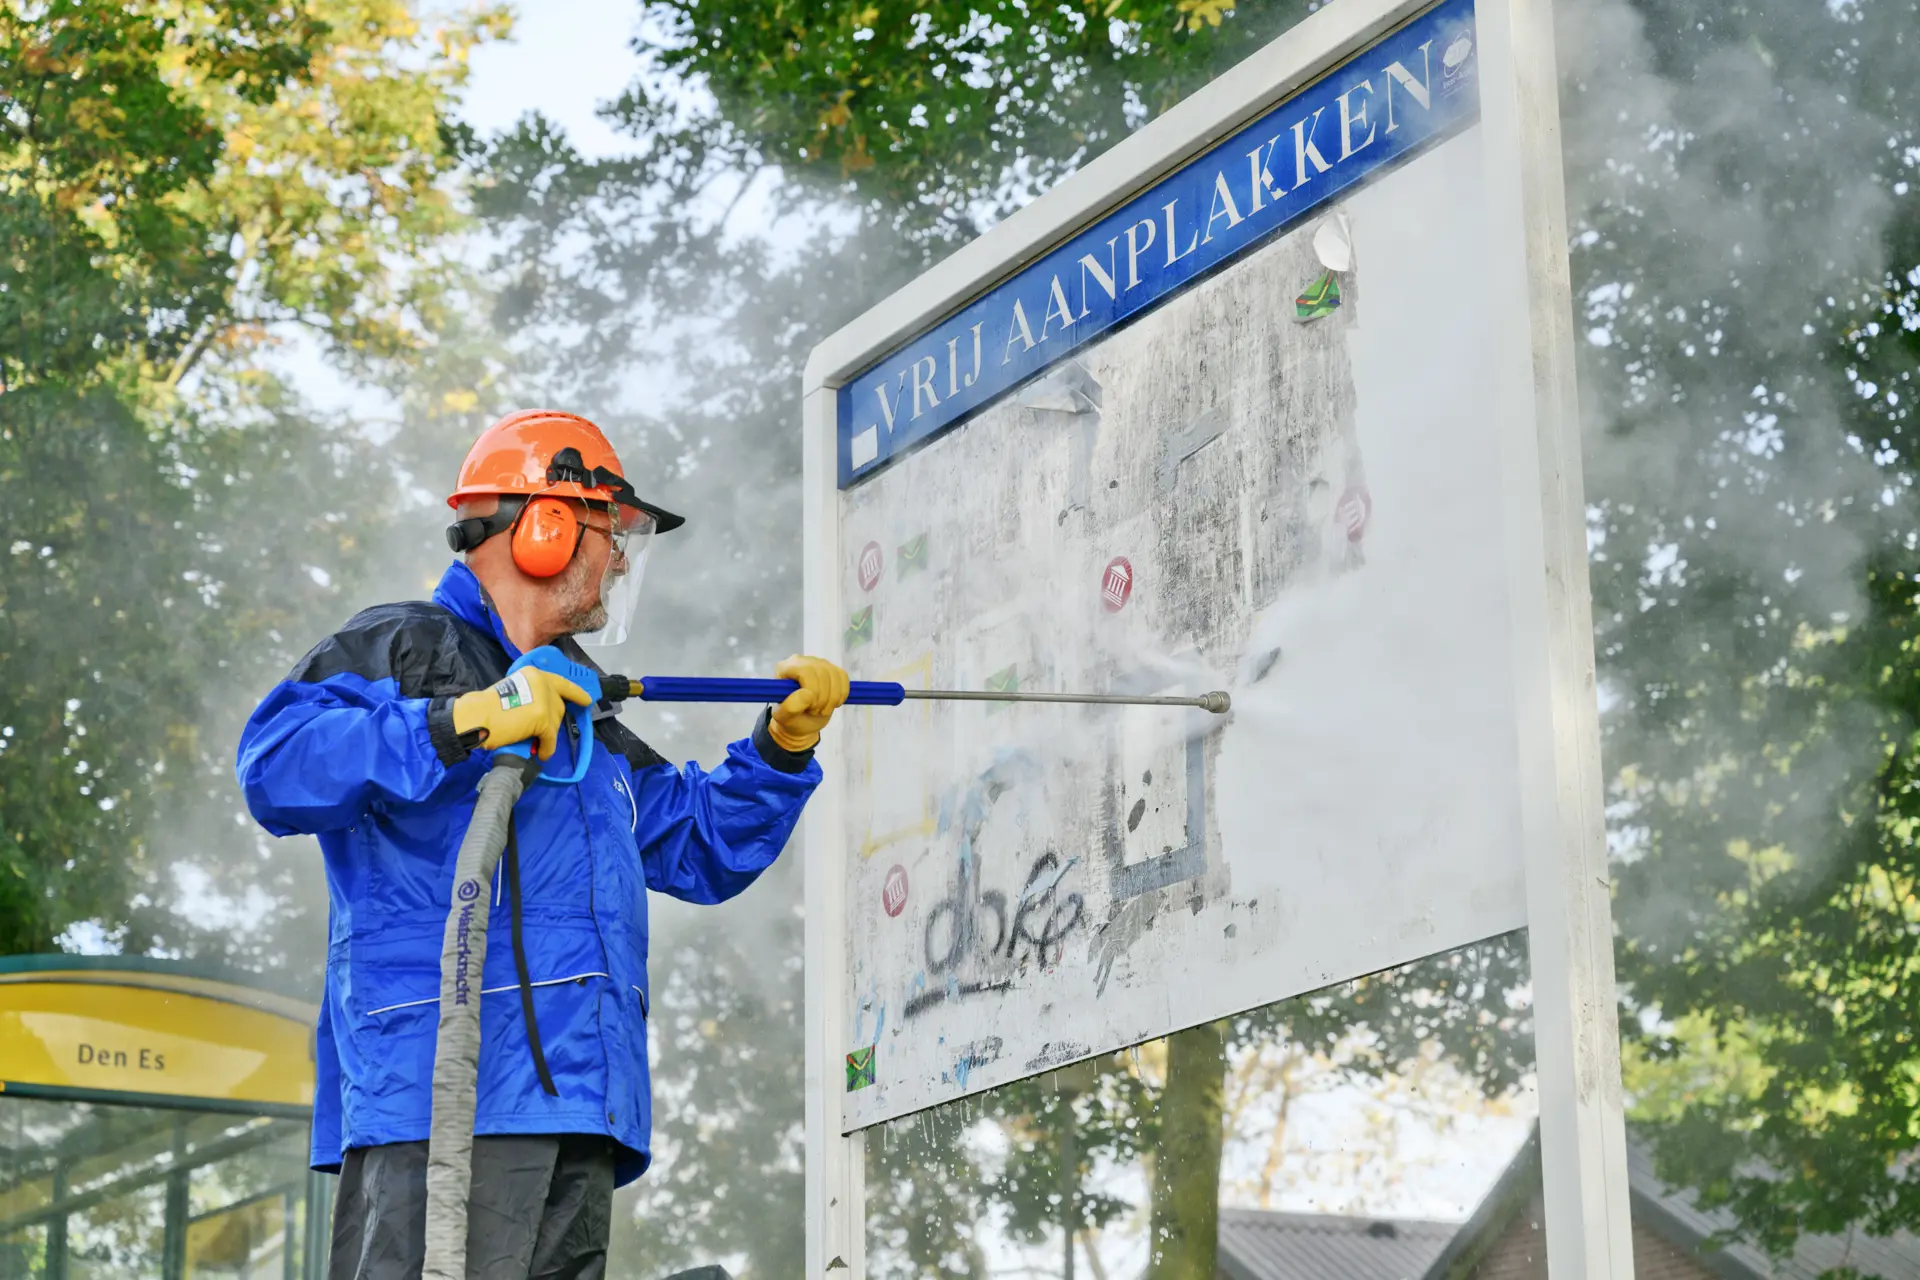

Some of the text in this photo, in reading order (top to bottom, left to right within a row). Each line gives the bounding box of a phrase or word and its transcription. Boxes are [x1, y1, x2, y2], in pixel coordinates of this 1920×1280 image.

[874, 39, 1433, 435] VRIJ AANPLAKKEN
[455, 902, 475, 1006] Waterkracht
[78, 1043, 165, 1070] Den Es
